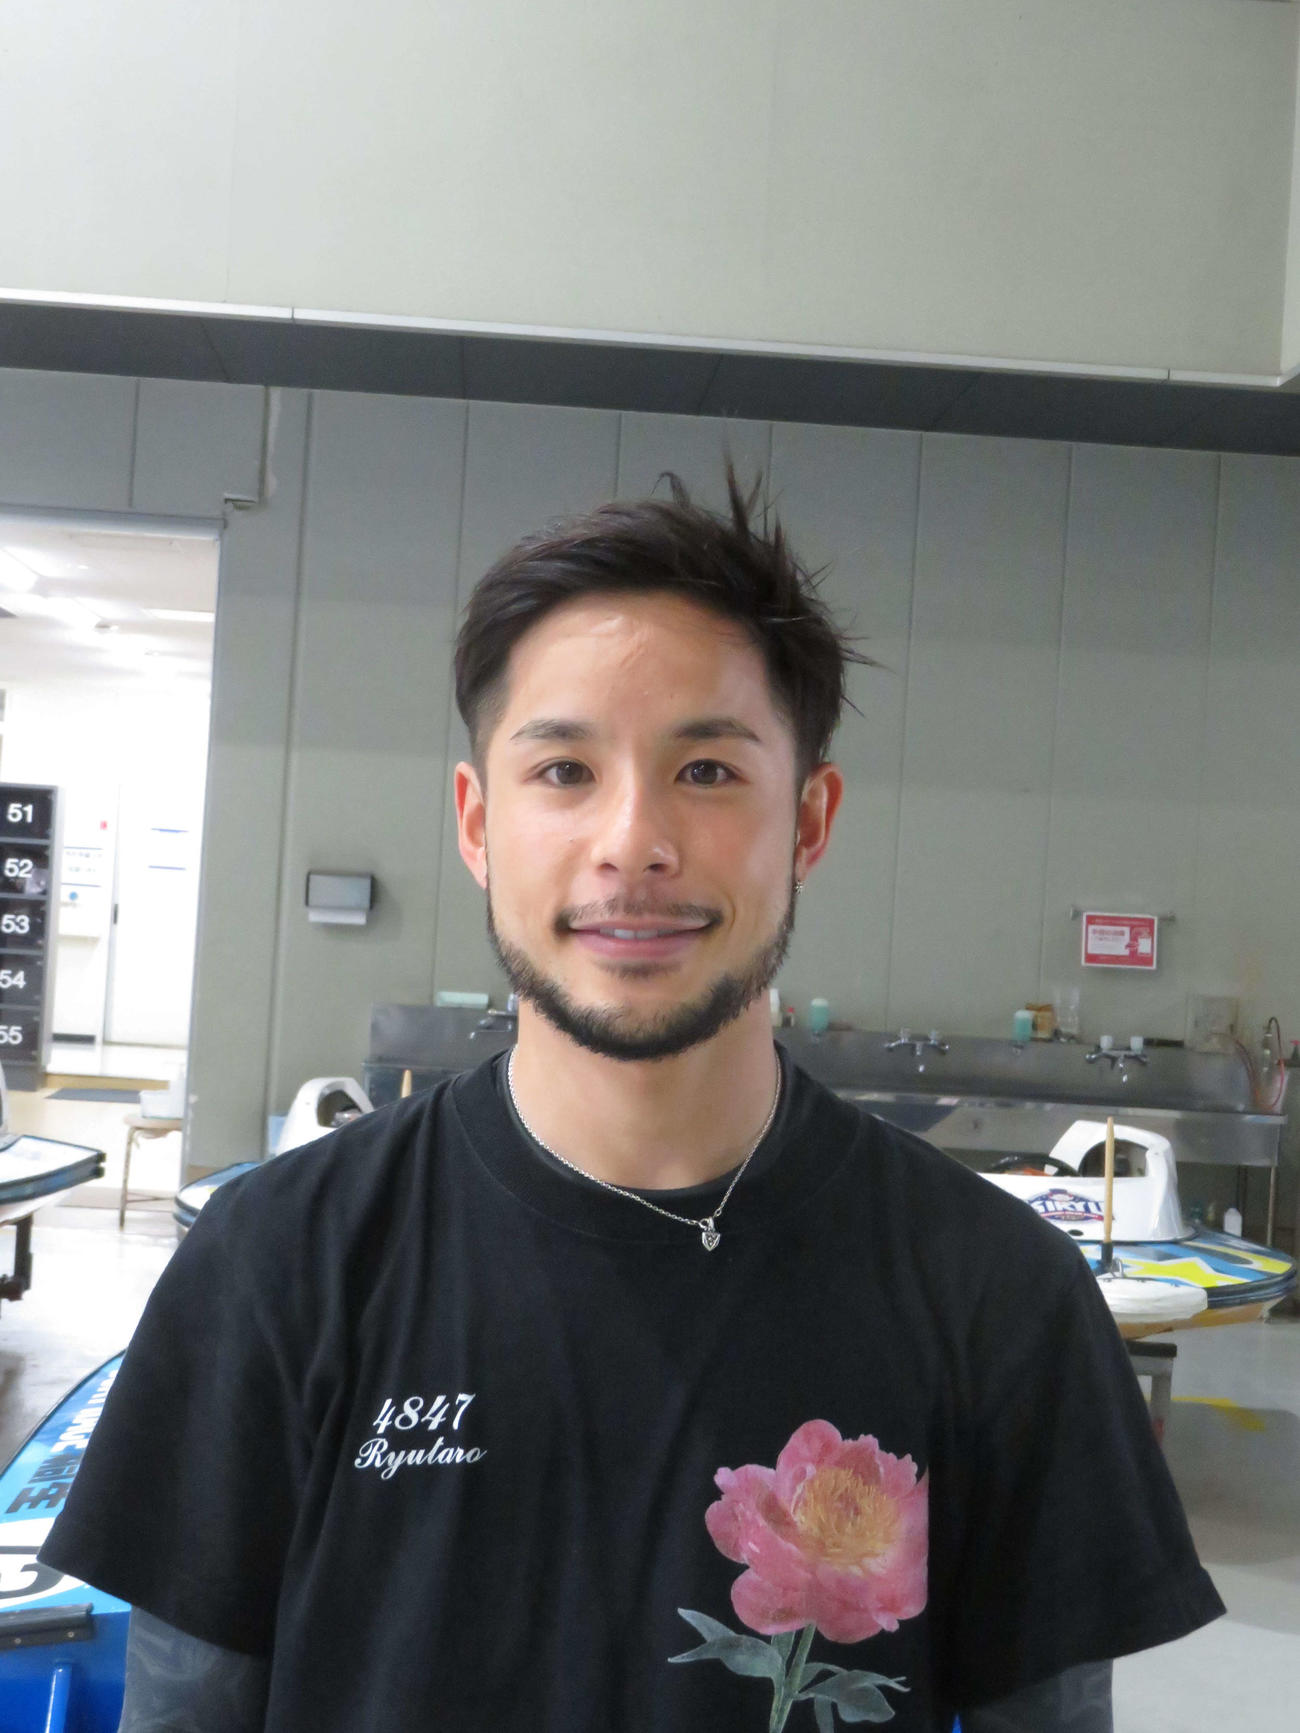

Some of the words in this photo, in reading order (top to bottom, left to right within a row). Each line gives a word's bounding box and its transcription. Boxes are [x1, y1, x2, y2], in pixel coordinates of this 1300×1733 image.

[7, 803, 34, 823] 51
[4, 858, 34, 878] 52
[1, 915, 30, 934] 53
[0, 970, 27, 989] 54
[372, 1393, 476, 1434] 4847
[354, 1436, 488, 1480] Ryutaro
